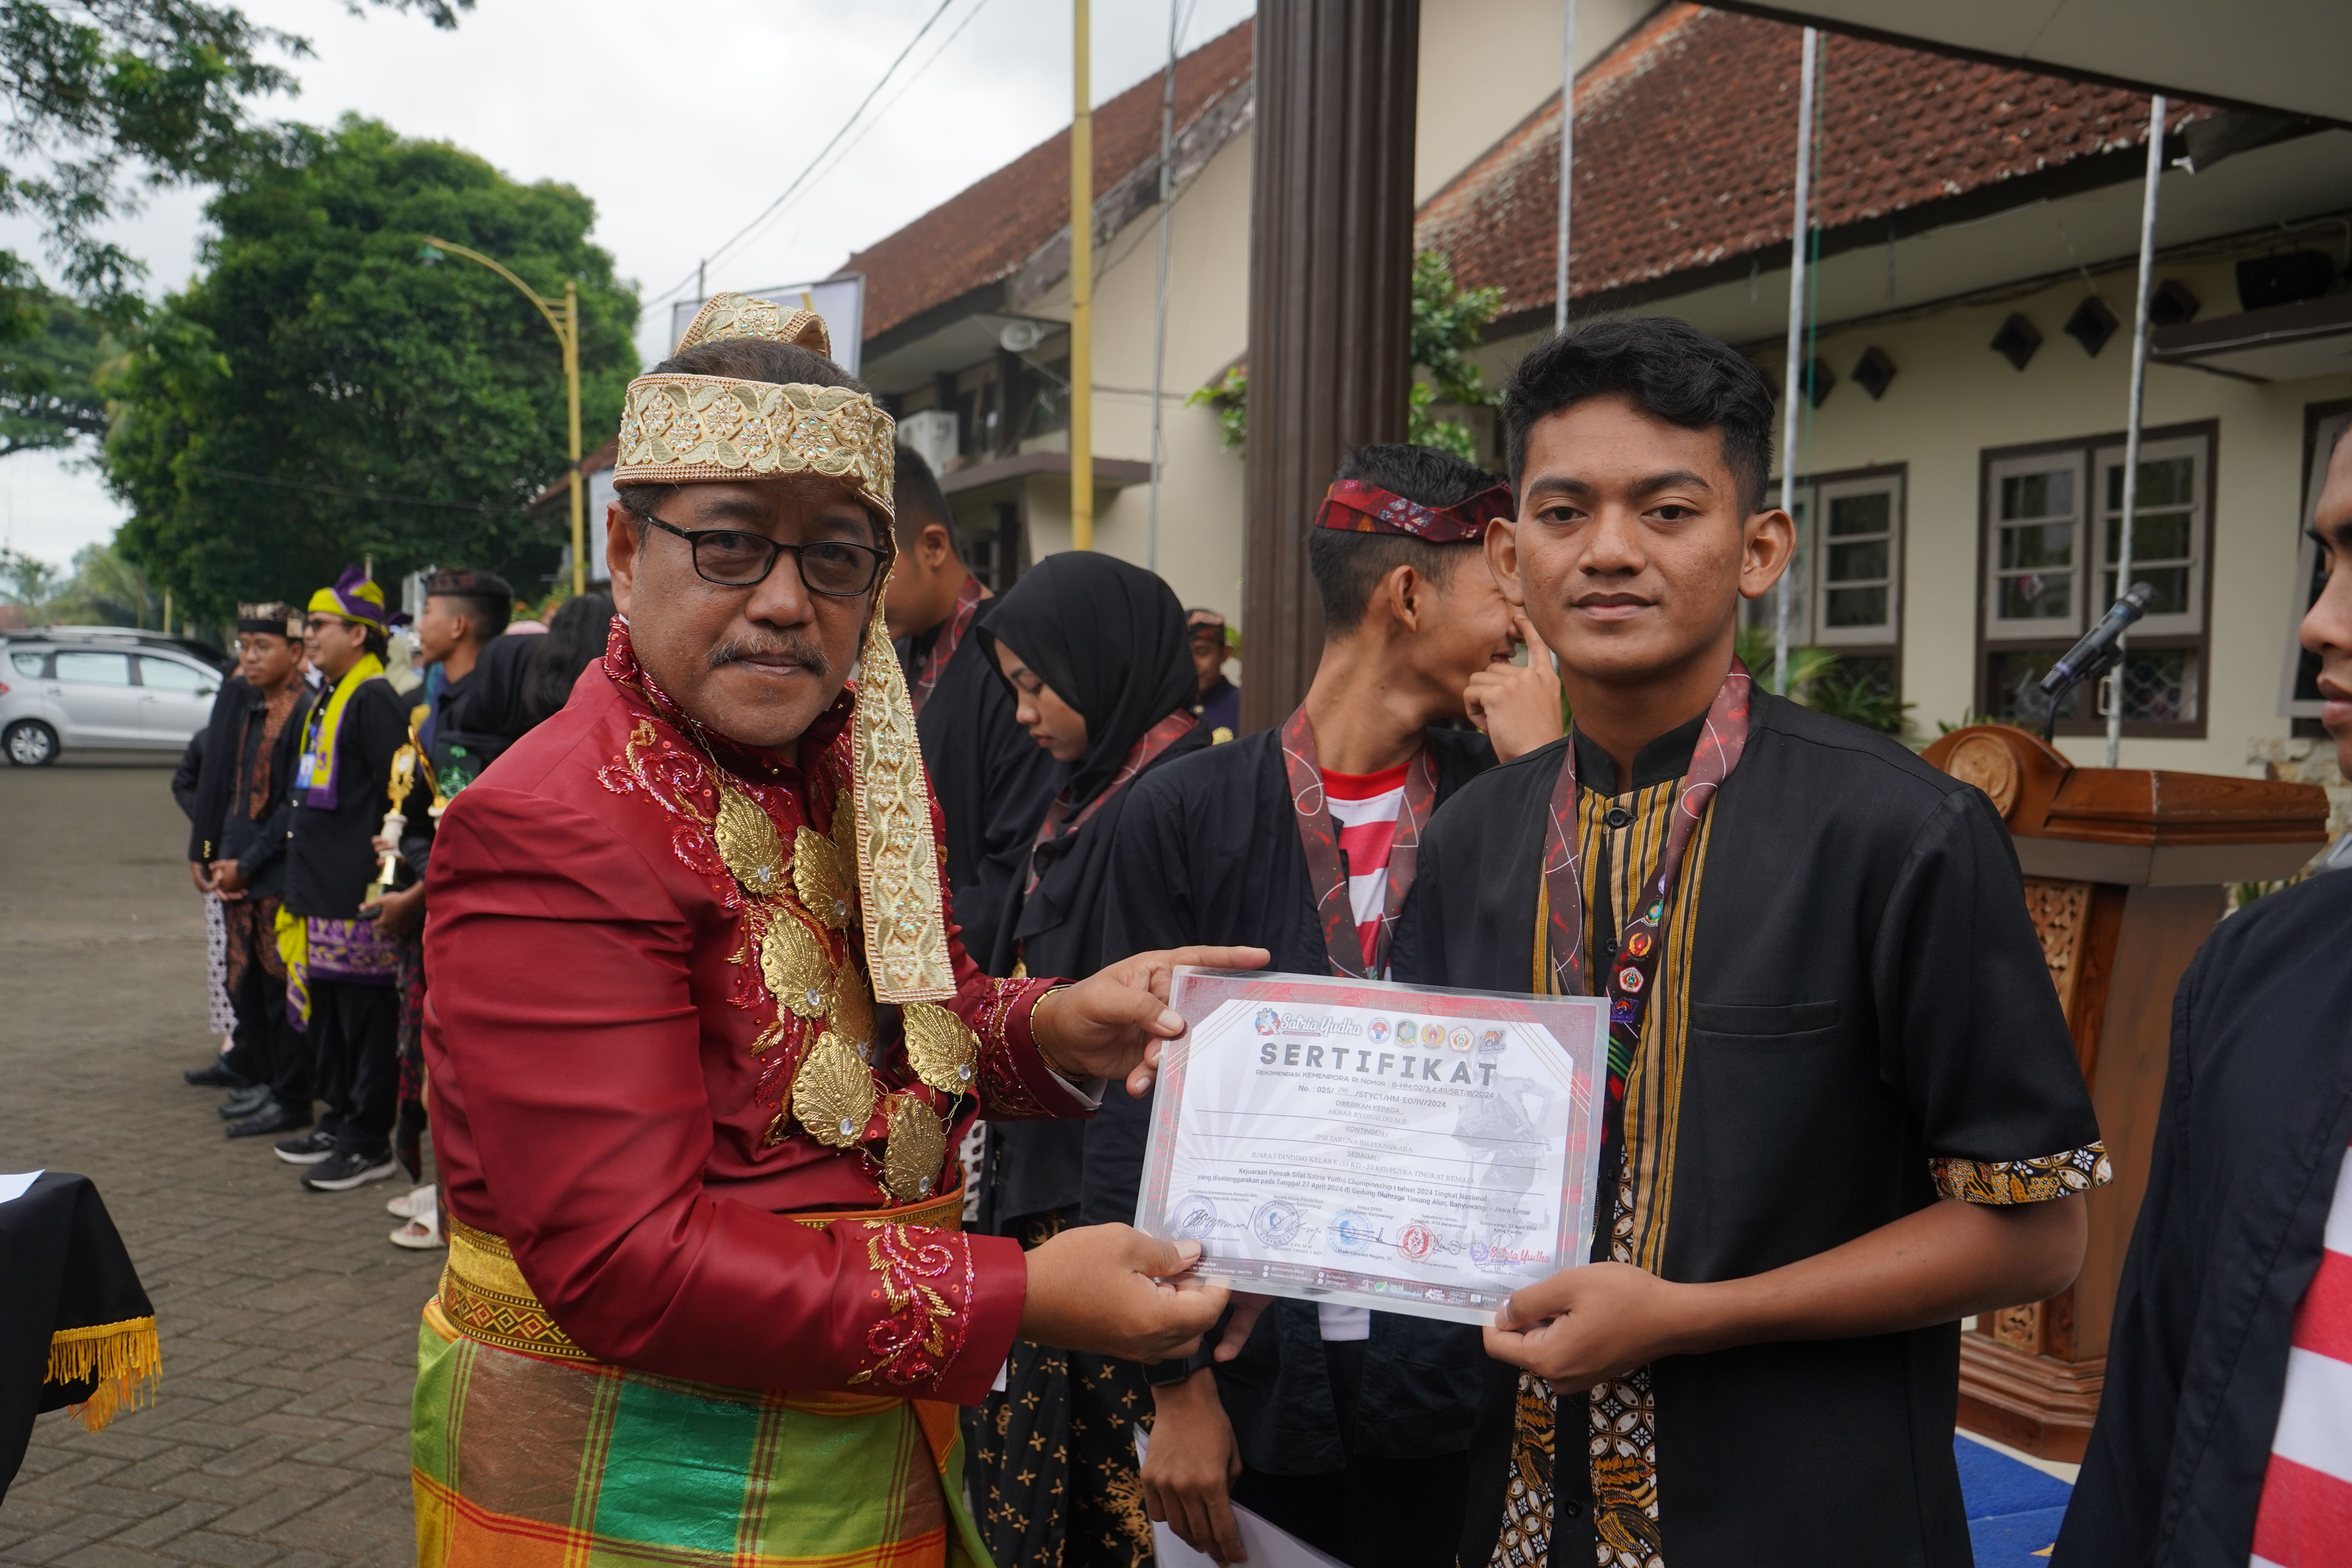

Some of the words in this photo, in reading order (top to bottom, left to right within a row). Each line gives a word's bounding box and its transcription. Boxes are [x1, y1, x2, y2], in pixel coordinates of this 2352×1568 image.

[1281, 1014, 1319, 1031] Satria
[1320, 1016, 1362, 1037] Yudha
[1260, 1043, 1497, 1086] SERTIFIKAT
[1303, 1072, 1349, 1082] KEMENPORA
[1336, 1100, 1371, 1109] DIBERIKAN
[1354, 1112, 1393, 1123] RYONALDO
[1346, 1126, 1384, 1136] KONTINGEN
[1329, 1136, 1358, 1145] TARUNA
[1359, 1140, 1413, 1152] BHAYANGKARA
[1347, 1151, 1377, 1160] SEBAGAI
[1277, 1154, 1308, 1162] TANDING
[1390, 1167, 1412, 1176] PUTRA
[1414, 1171, 1444, 1180] TINGKAT
[1446, 1175, 1474, 1184] REMAJA
[1212, 1175, 1259, 1184] diselenggarakan
[1277, 1179, 1300, 1188] Tanggal
[1327, 1184, 1343, 1192] 2024
[1352, 1187, 1376, 1198] Gedung
[1377, 1191, 1405, 1201] Olahraga
[1406, 1195, 1430, 1205] Tawang
[1432, 1198, 1448, 1207] Alun,
[1450, 1200, 1488, 1212] Banyuwangi
[1494, 1205, 1511, 1214] Jawa
[1512, 1207, 1531, 1216] Timur
[1348, 1178, 1392, 1190] Championship
[1397, 1185, 1416, 1193] tahun
[1434, 1190, 1457, 1200] Tingkat
[1459, 1193, 1487, 1202] Nasional
[1421, 1260, 1457, 1270] Hidayaturrahman
[1520, 1249, 1550, 1265] Yudha
